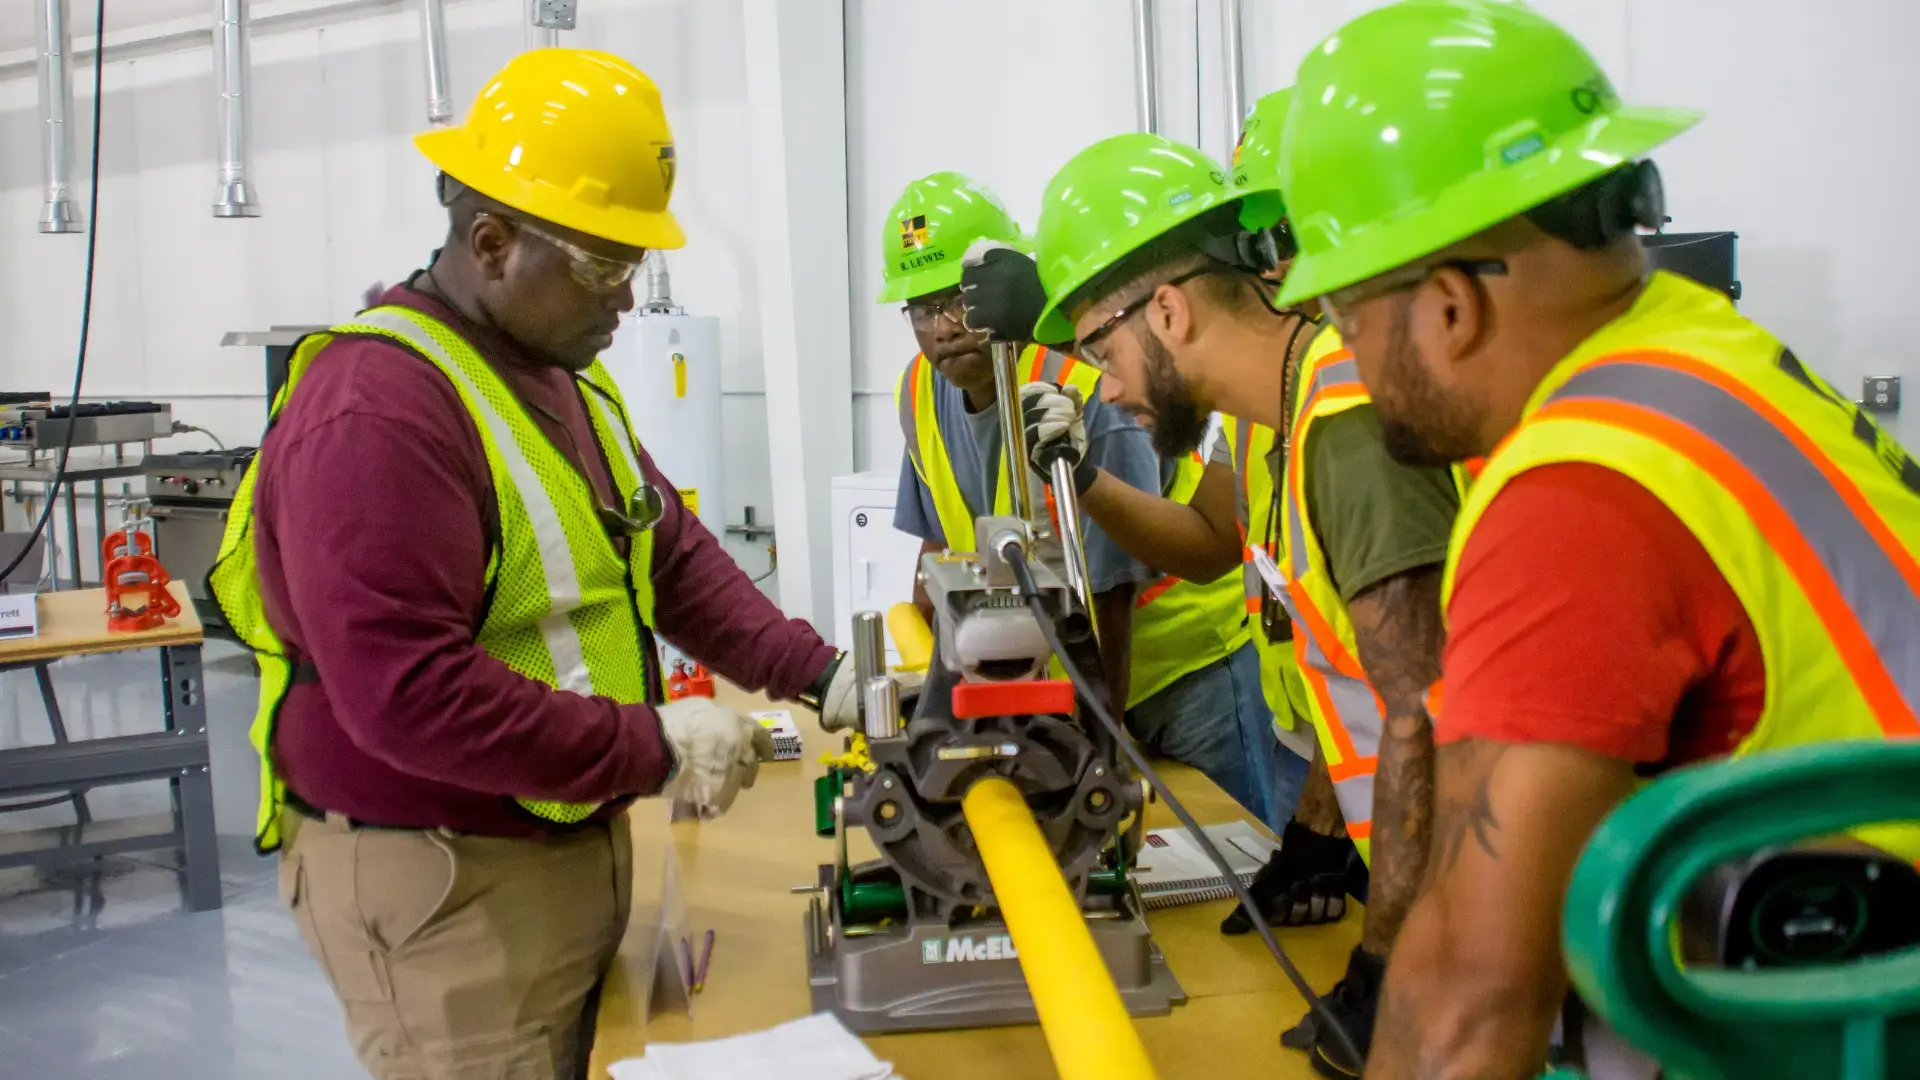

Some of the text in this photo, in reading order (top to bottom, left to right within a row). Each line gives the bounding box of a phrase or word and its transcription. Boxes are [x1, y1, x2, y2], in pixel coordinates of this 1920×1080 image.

[900, 261, 909, 271] R.
[910, 250, 945, 268] LEWIS
[0, 609, 19, 618] rett
[946, 936, 1017, 962] McEL
